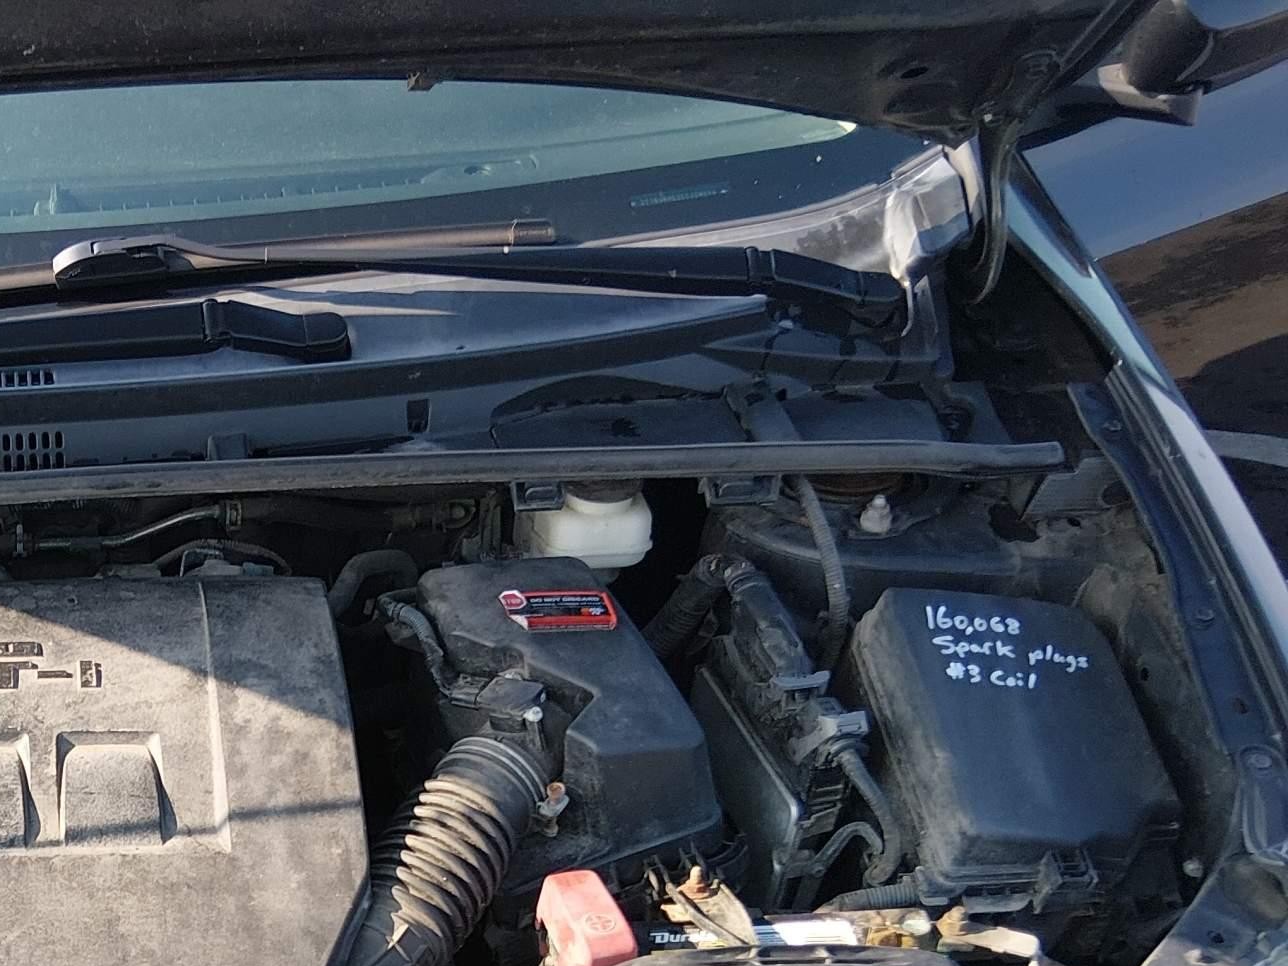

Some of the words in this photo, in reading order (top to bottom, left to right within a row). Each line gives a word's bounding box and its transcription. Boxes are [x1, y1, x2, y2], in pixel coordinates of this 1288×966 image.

[932, 635, 1016, 658] Spark
[1028, 644, 1089, 672] plugs
[945, 661, 981, 683] #3
